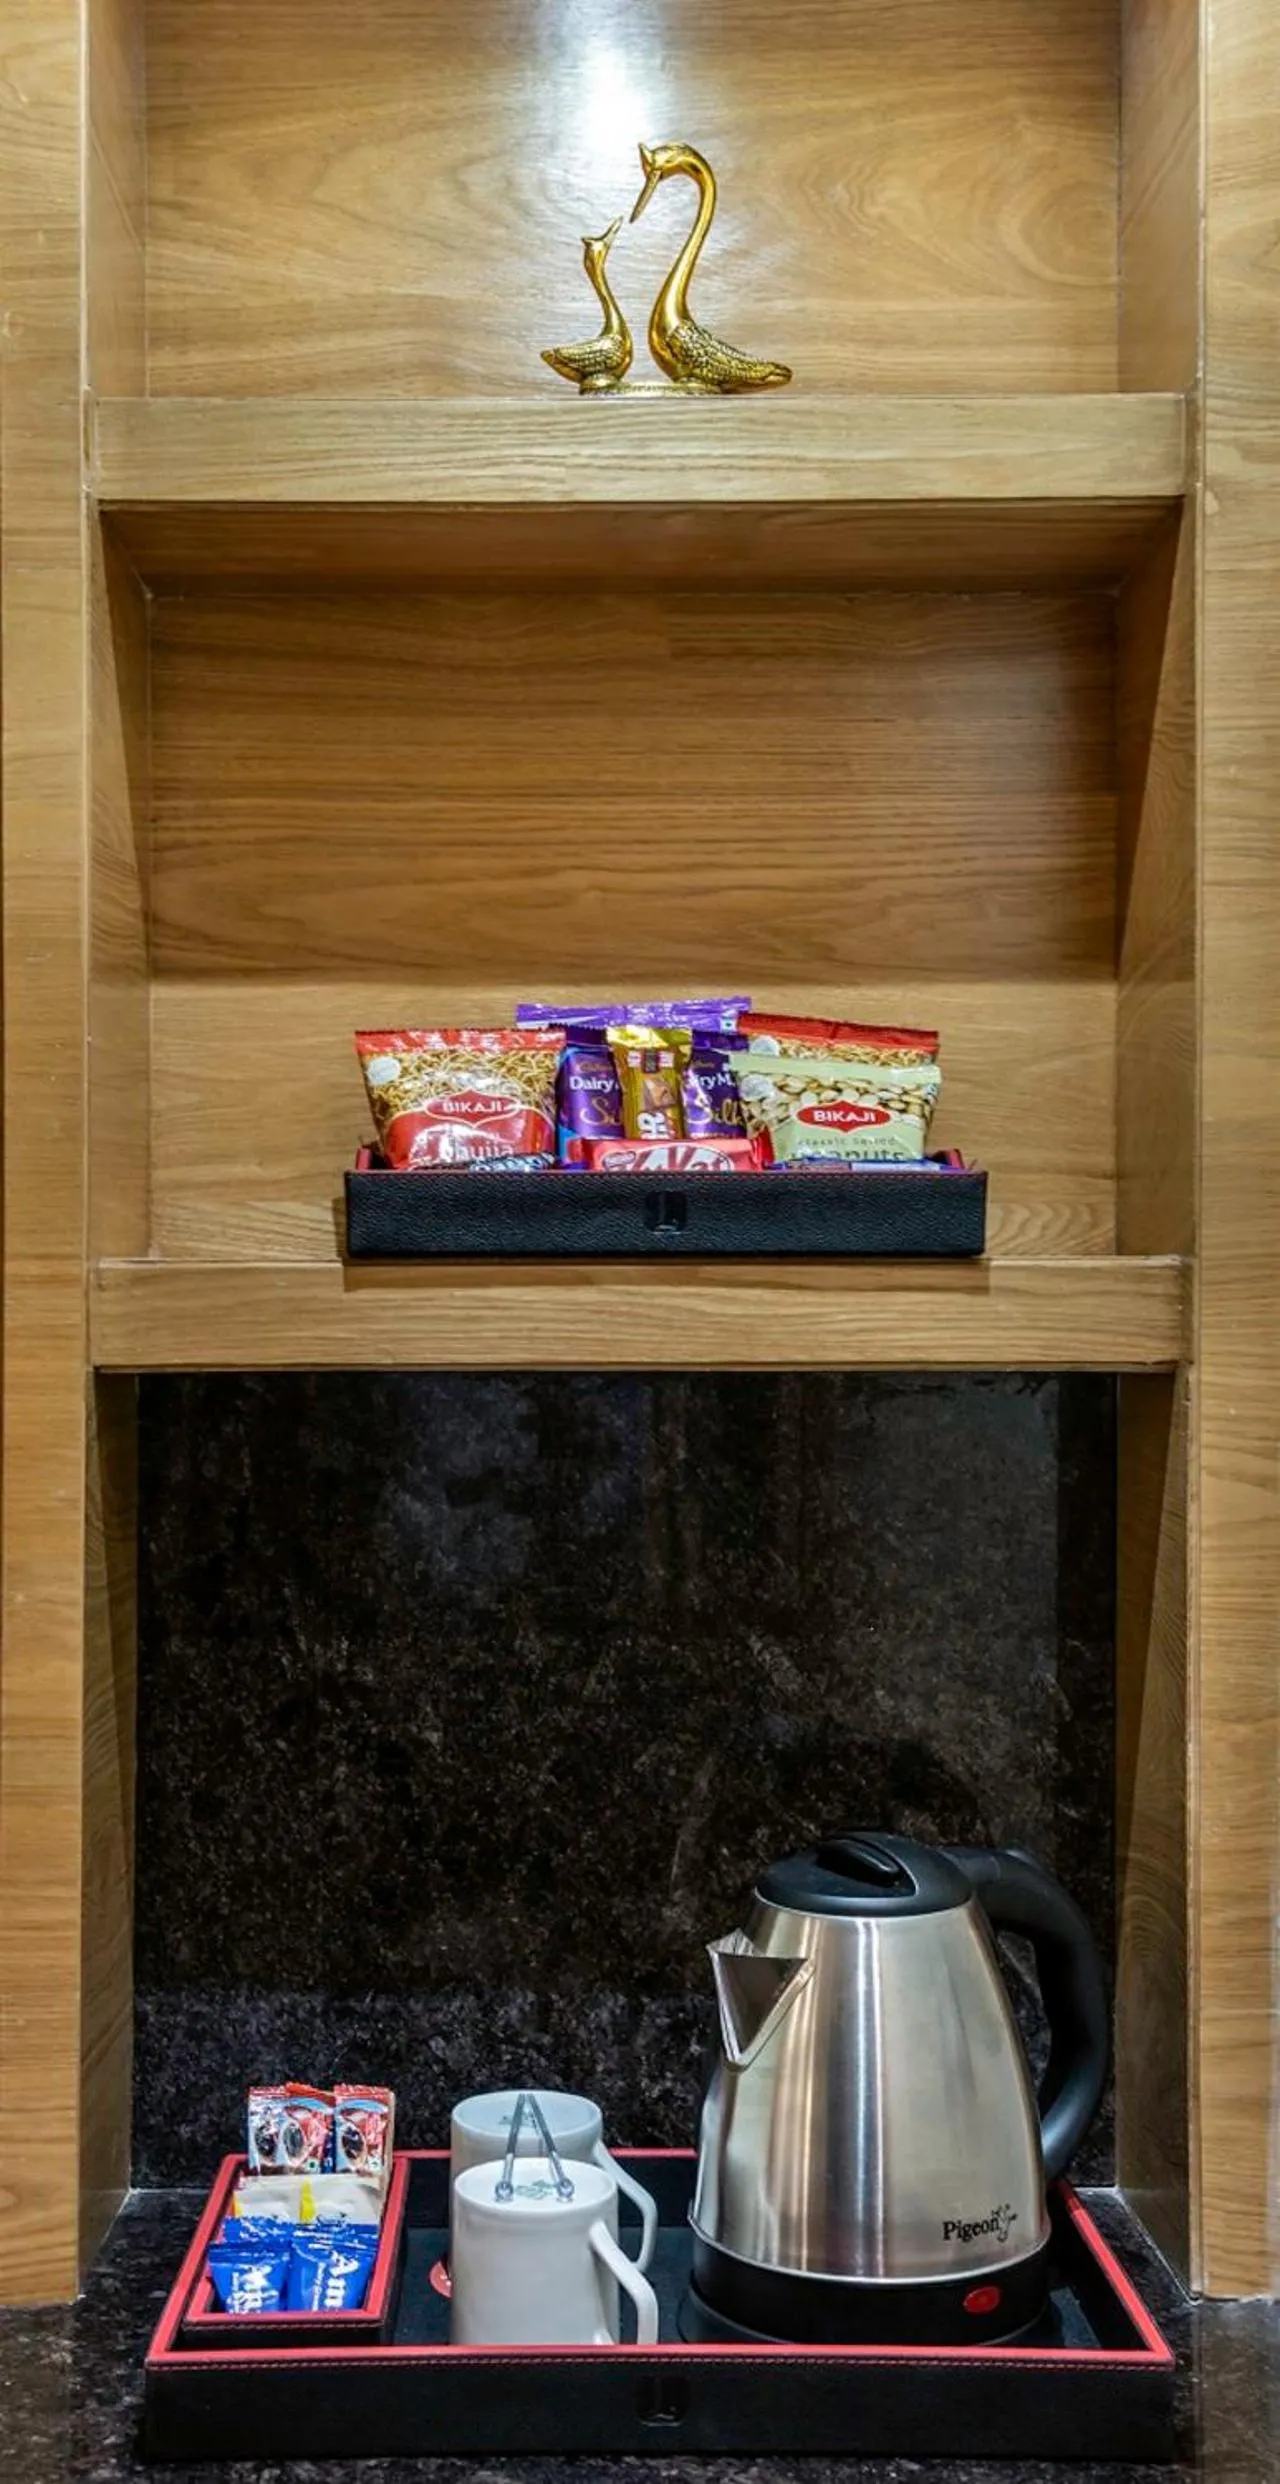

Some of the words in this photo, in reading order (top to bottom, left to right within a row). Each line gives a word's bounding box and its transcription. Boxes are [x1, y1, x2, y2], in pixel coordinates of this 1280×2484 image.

[568, 1075, 614, 1094] Dairy
[442, 1100, 502, 1113] BIKAJI
[812, 1109, 876, 1123] BIKAJI
[942, 2216, 1000, 2243] Pigeon
